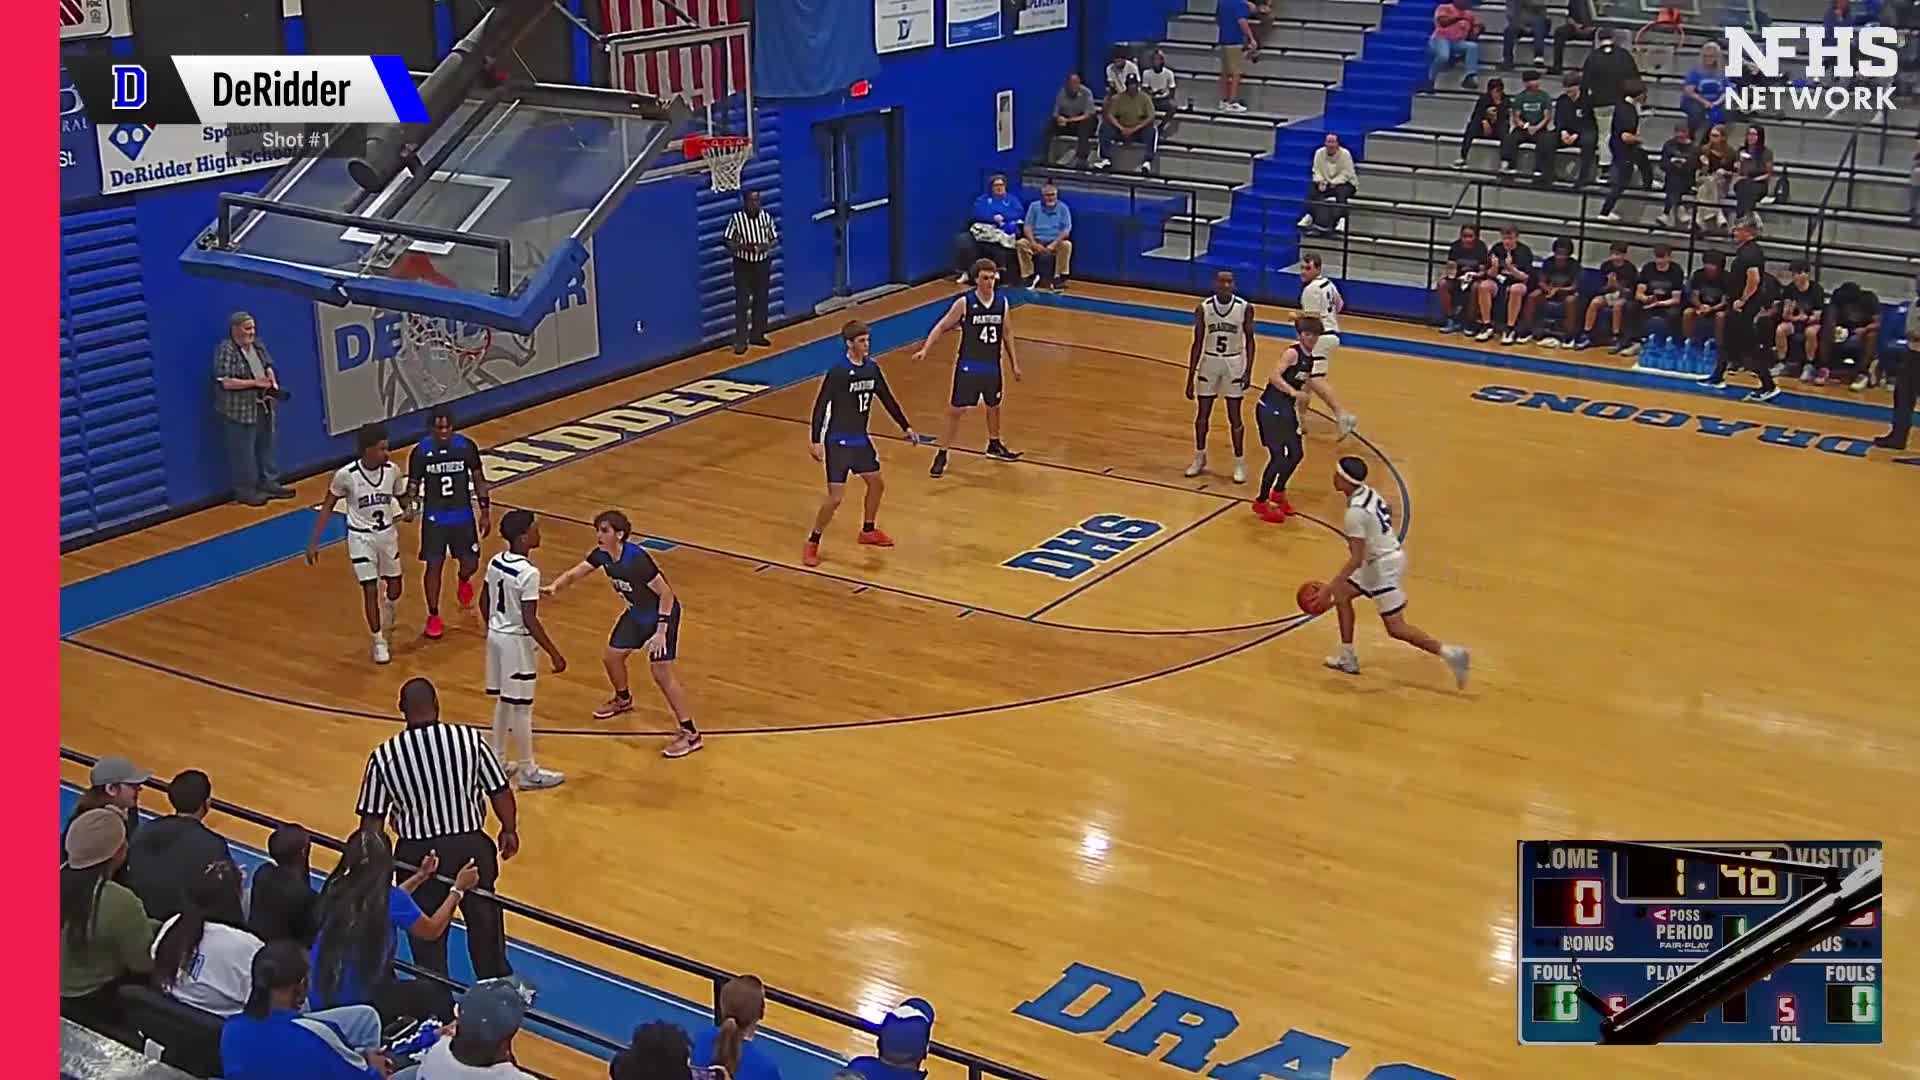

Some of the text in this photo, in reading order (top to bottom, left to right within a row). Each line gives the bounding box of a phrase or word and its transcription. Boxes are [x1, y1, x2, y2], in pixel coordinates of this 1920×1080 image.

[110, 160, 192, 187] DeRidder
[195, 152, 238, 173] High
[980, 326, 998, 343] 43
[1216, 336, 1228, 353] 5
[858, 392, 870, 412] 12
[441, 476, 454, 496] 2
[372, 510, 385, 531] 3
[999, 513, 1167, 581] DHS
[496, 579, 506, 614] 1
[1537, 848, 1599, 869] OME
[1574, 880, 1602, 925] 0
[1669, 909, 1700, 922] POSS
[1656, 924, 1714, 940] PERIOD
[1563, 935, 1614, 951] BONUS
[1533, 964, 1582, 981] FOULS
[1826, 965, 1875, 982] FOULS
[1779, 997, 1795, 1022] 5
[1851, 986, 1874, 1022] 0
[1770, 1025, 1800, 1042] TOL
